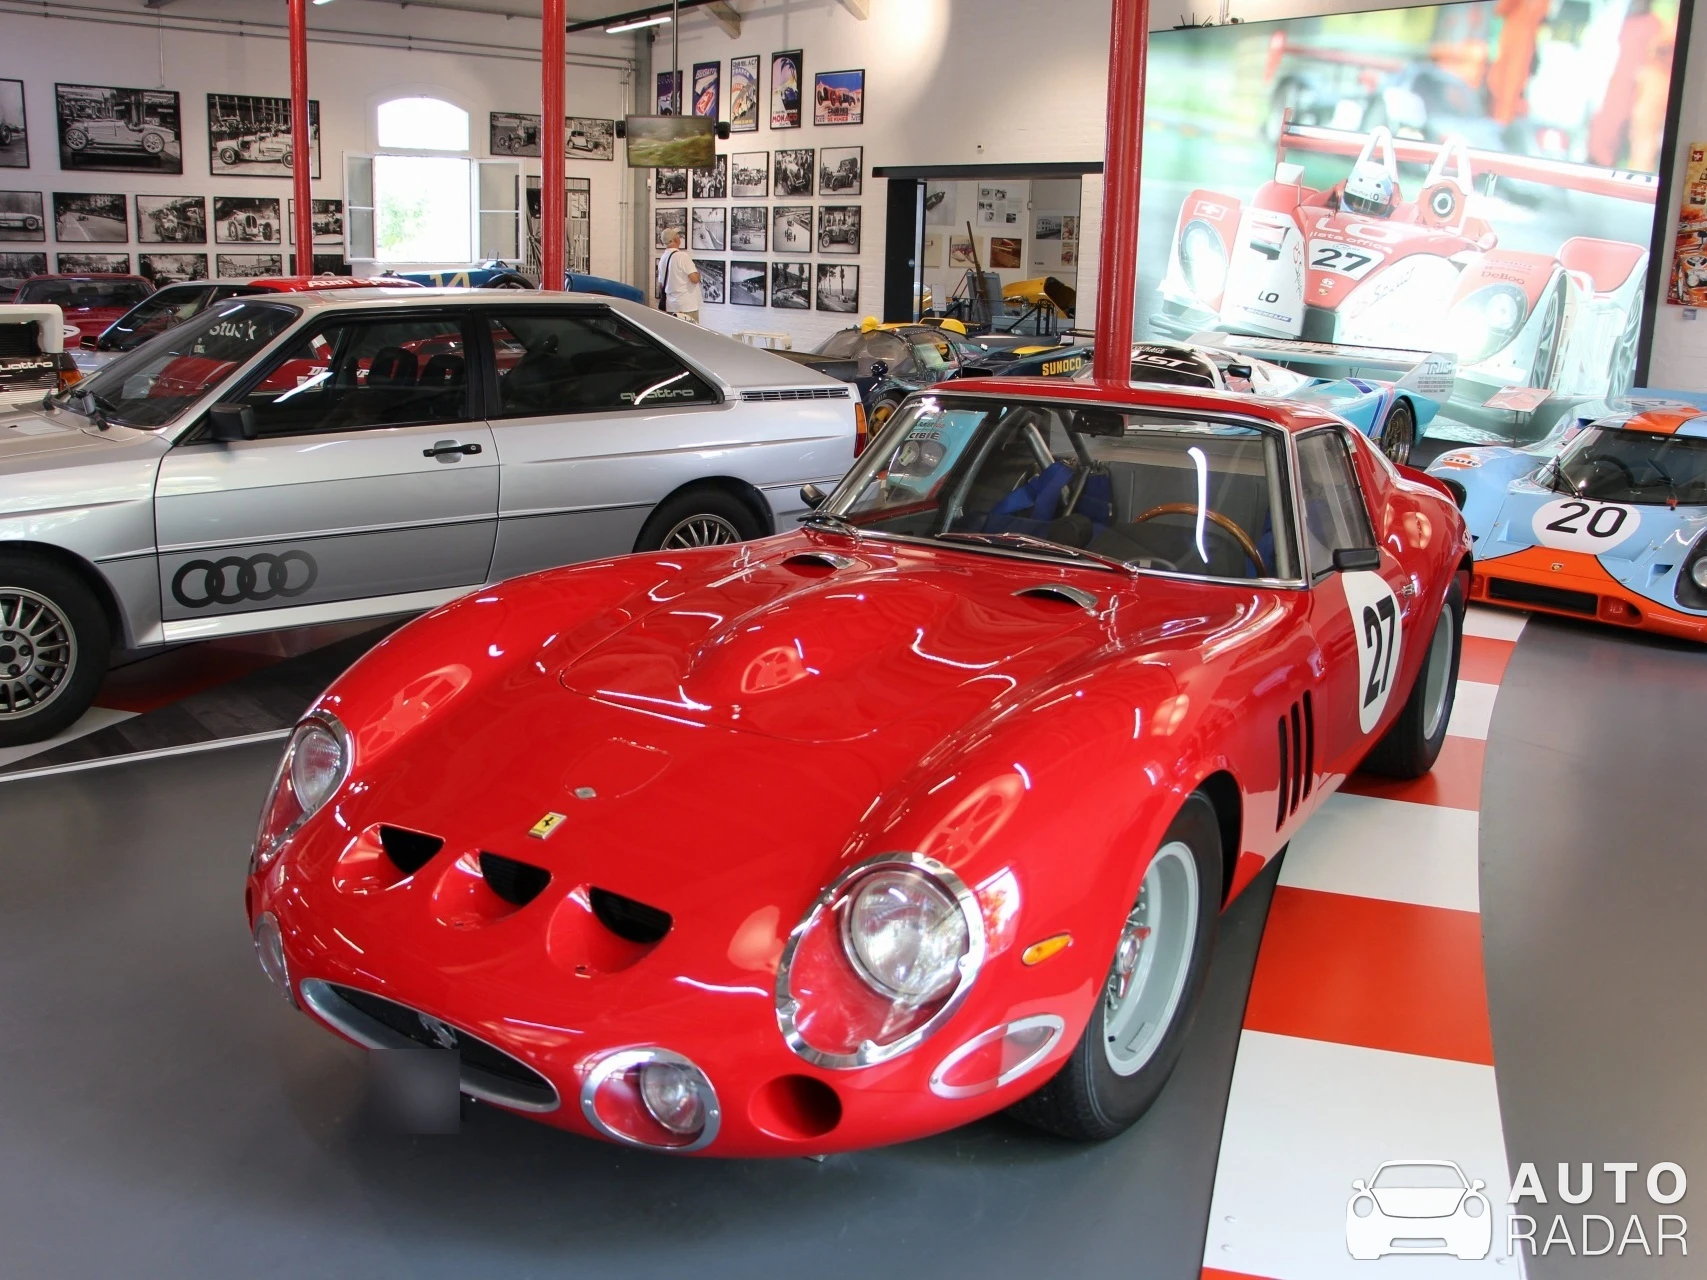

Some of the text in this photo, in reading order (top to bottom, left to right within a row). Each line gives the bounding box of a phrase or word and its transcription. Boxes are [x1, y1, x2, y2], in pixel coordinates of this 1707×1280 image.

[772, 113, 798, 123] MONACO
[1311, 248, 1372, 273] 27
[308, 279, 353, 288] Audi
[429, 272, 471, 288] 14
[1257, 290, 1280, 304] LO
[0, 361, 54, 373] uattro
[1042, 357, 1082, 376] SUNOCO
[620, 388, 695, 402] qattro
[1545, 502, 1628, 538] 20
[1362, 594, 1396, 708] 27
